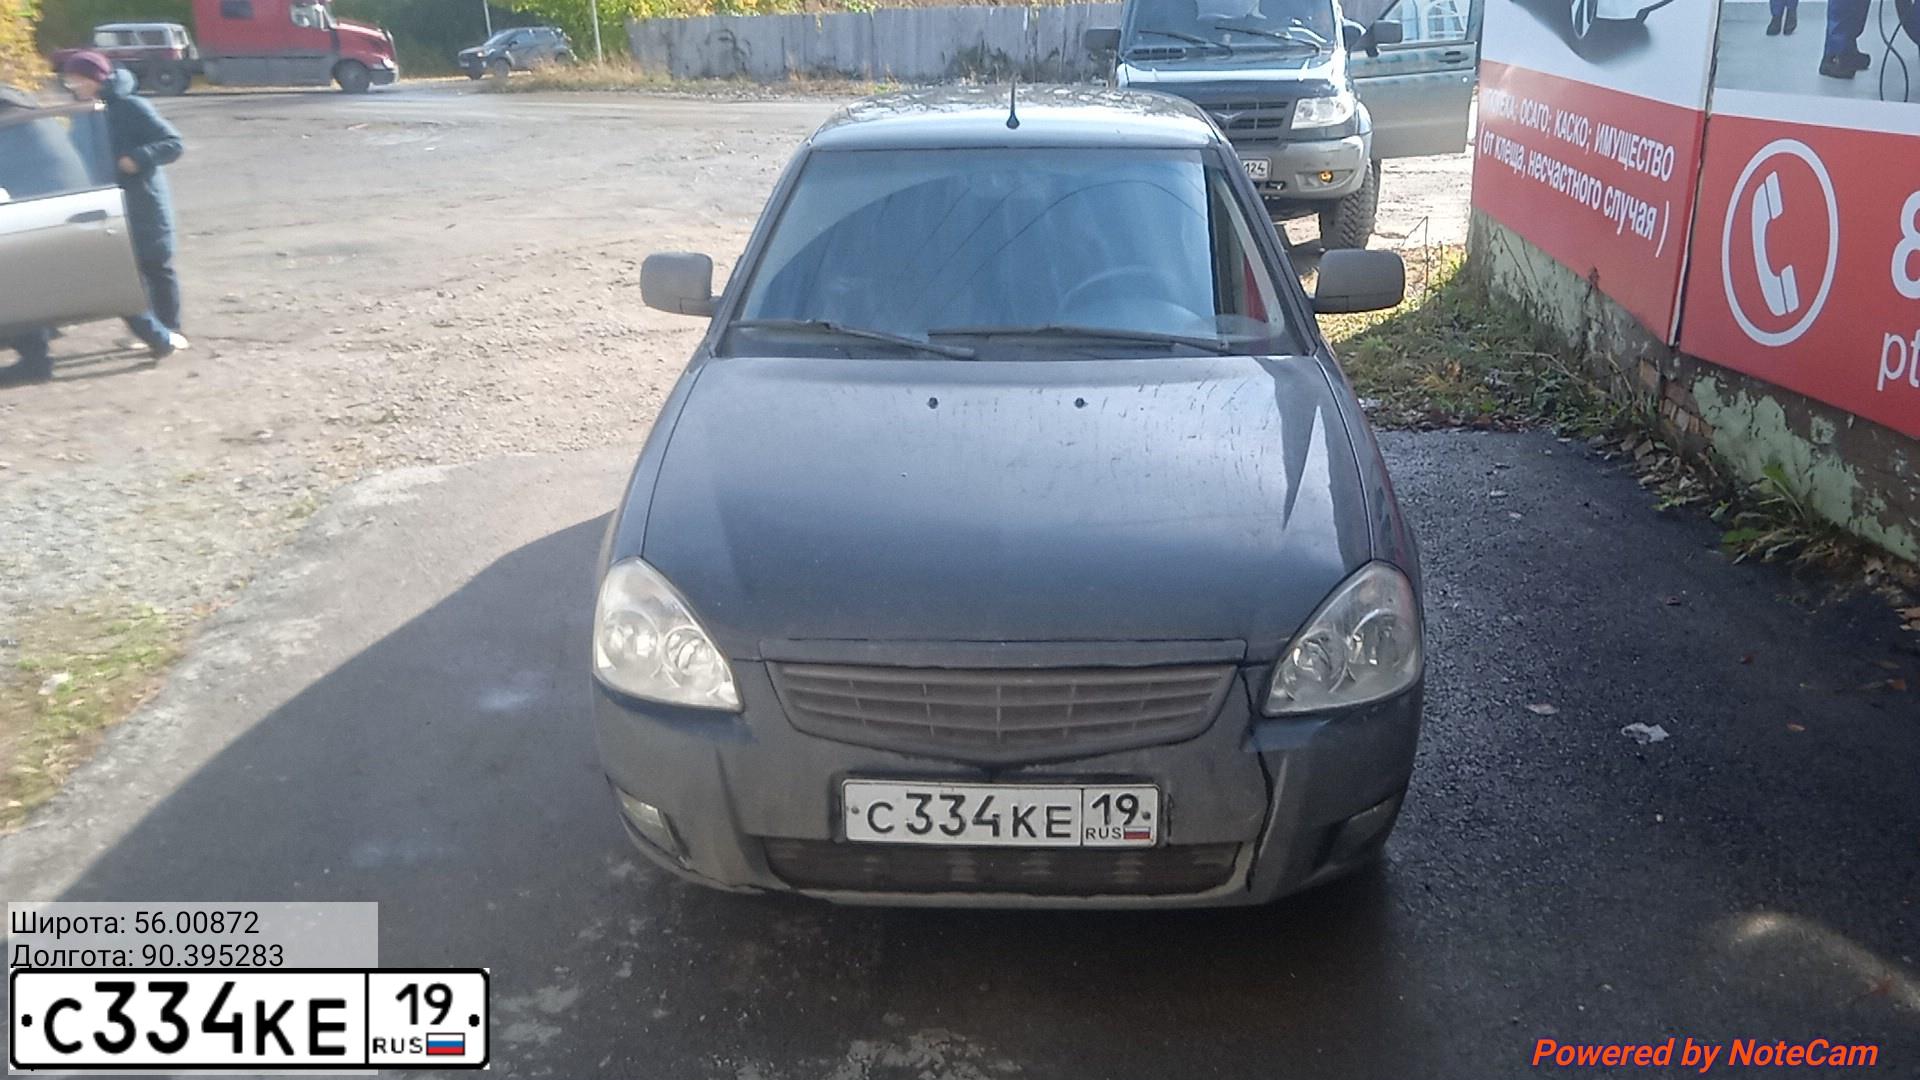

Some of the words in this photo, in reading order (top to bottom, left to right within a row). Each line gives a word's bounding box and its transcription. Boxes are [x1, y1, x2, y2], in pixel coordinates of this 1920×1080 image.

[1520, 98, 1552, 138] ОСАГО;
[1554, 108, 1591, 155] КАСКО;
[1594, 122, 1675, 182] ИМУЩЕСТВО
[1495, 135, 1526, 179] клеща,
[1527, 149, 1602, 211] несчастного
[1604, 186, 1657, 241] случая
[1085, 827, 1122, 840] RUS
[1090, 792, 1140, 826] 19
